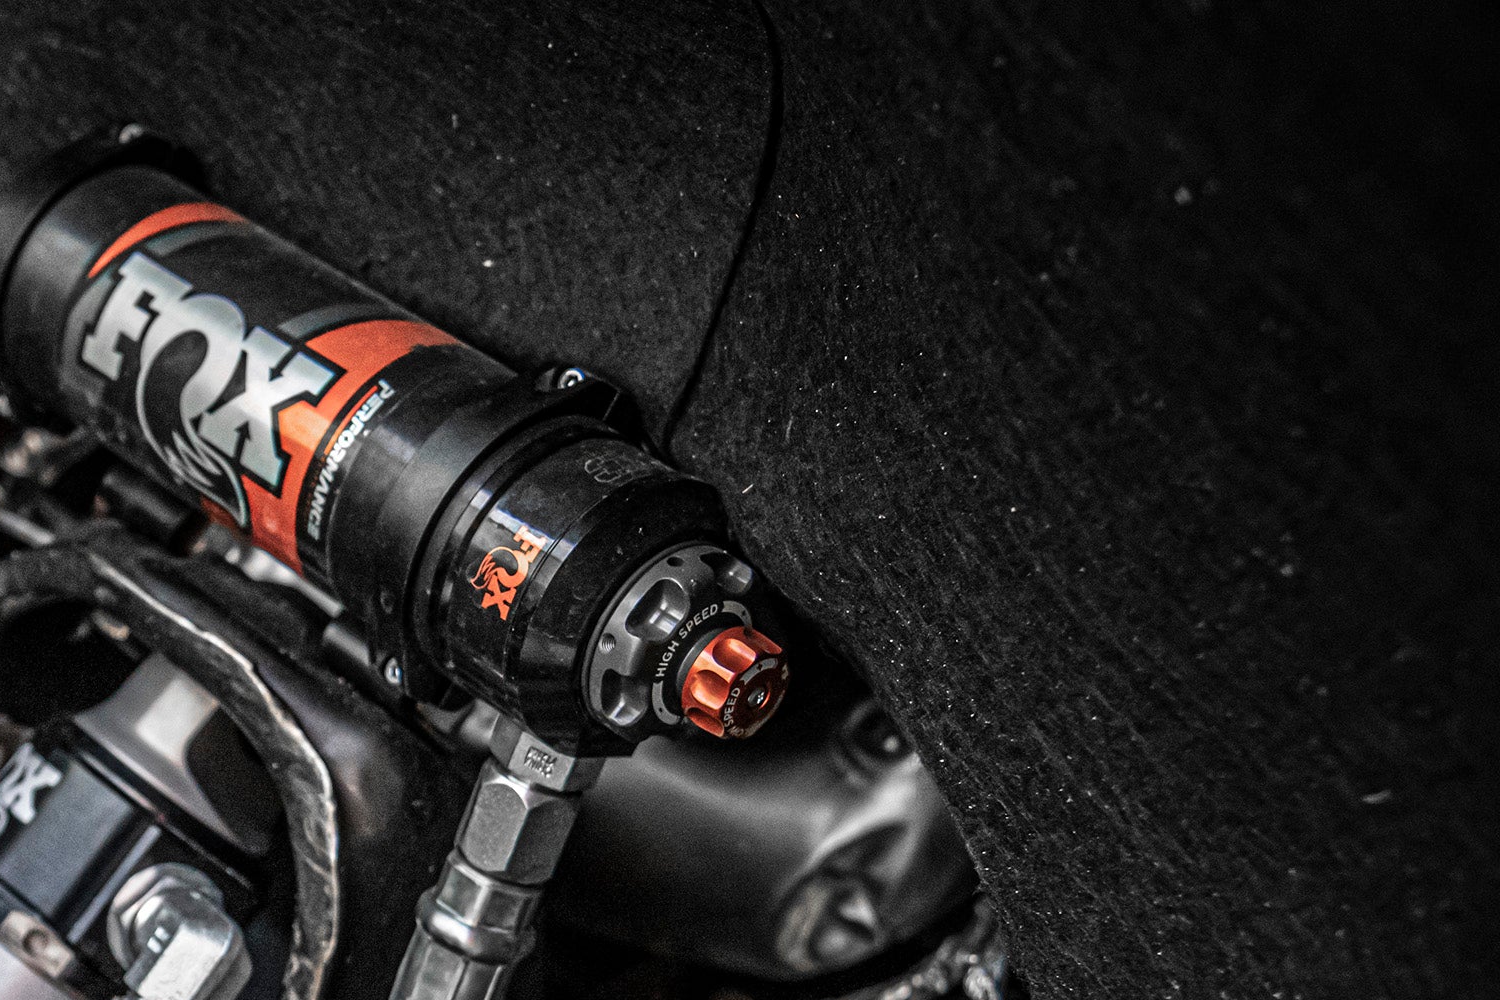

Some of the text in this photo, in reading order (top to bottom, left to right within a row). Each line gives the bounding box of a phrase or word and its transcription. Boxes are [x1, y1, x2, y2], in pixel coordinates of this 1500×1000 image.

[82, 251, 336, 526] FOX
[307, 378, 396, 541] PERFORMANCE
[470, 525, 547, 621] FOX
[655, 603, 719, 678] HIGH SPEED
[723, 687, 741, 727] SPEED
